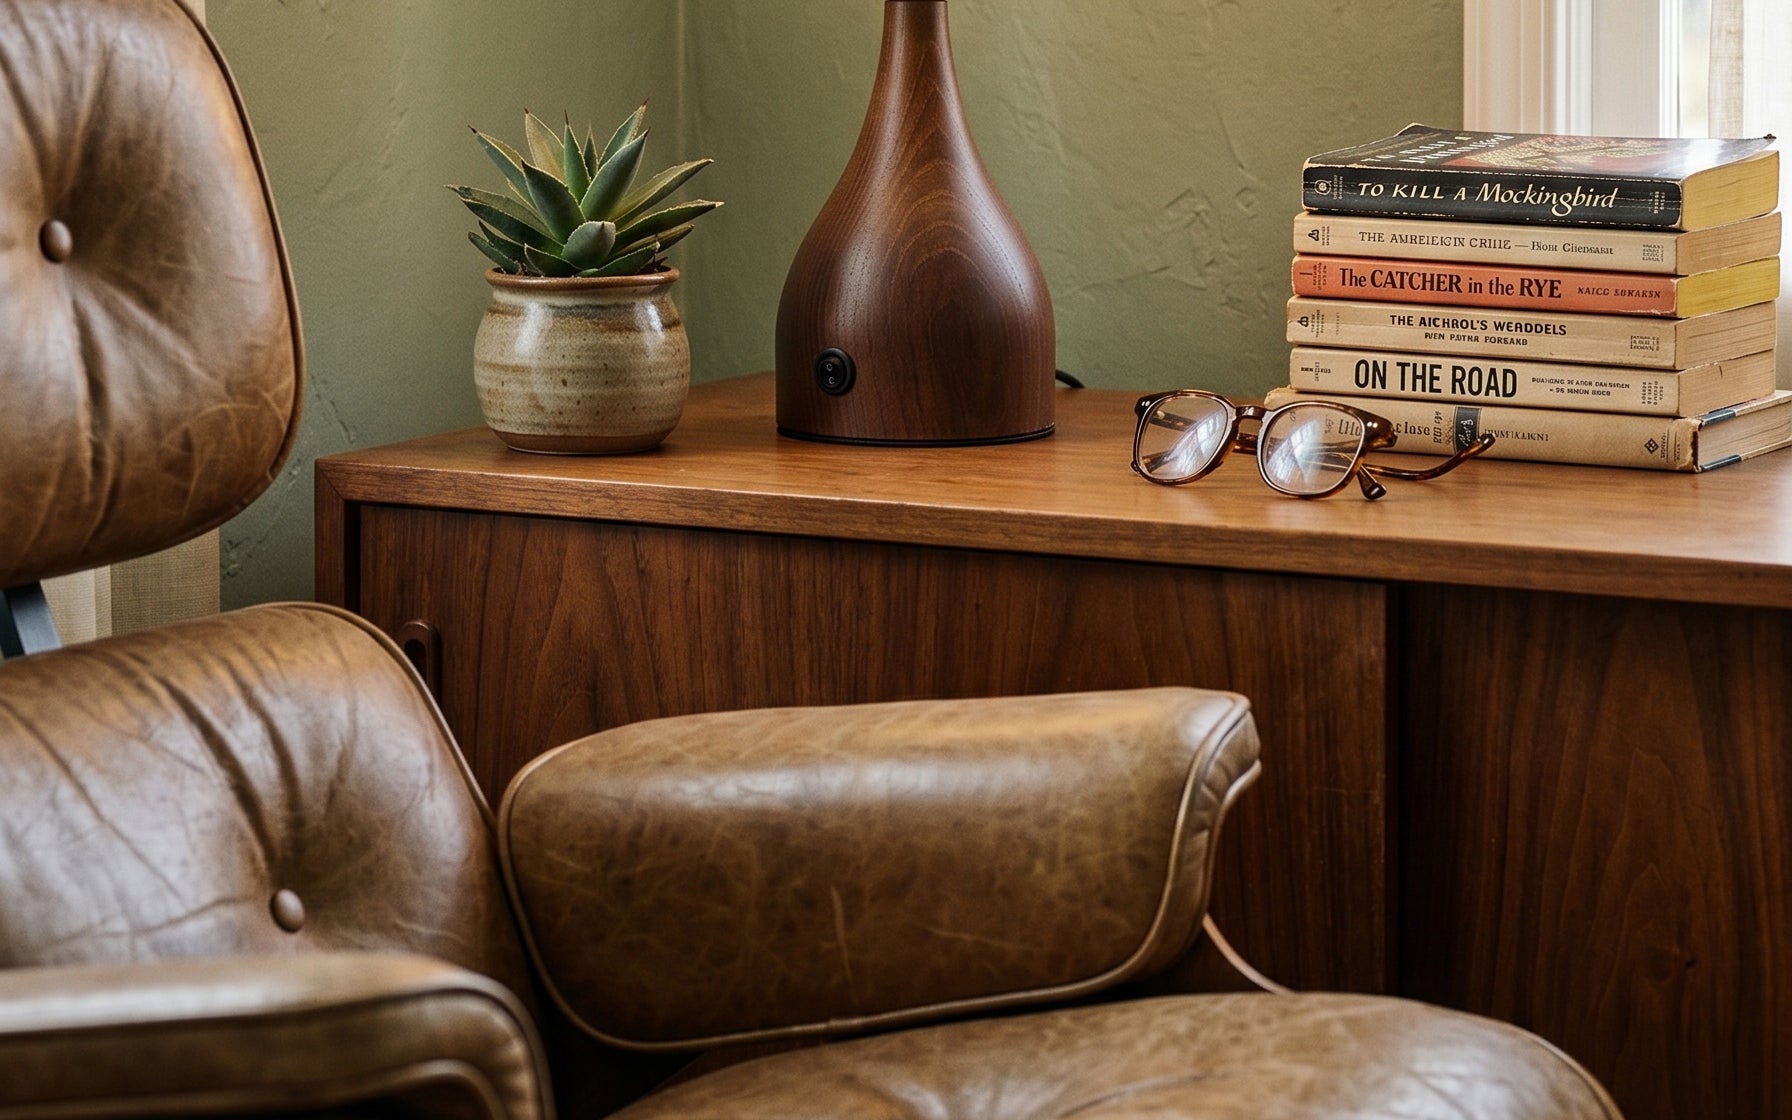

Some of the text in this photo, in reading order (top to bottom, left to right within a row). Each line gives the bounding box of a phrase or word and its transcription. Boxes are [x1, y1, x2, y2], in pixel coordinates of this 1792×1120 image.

[1358, 182, 1384, 197] TO
[1392, 184, 1445, 200] KILL
[1453, 187, 1466, 201] A
[1475, 182, 1619, 217] Mockingbird
[1359, 232, 1385, 243] THE
[1339, 268, 1367, 288] The
[1370, 269, 1463, 293] CATCHER
[1468, 277, 1483, 294] in
[1488, 277, 1514, 297] the
[1519, 278, 1562, 299] RYE
[1390, 314, 1414, 327] THE
[1354, 359, 1387, 390] ON
[1396, 361, 1442, 394] THE
[1451, 365, 1518, 399] ROAD
